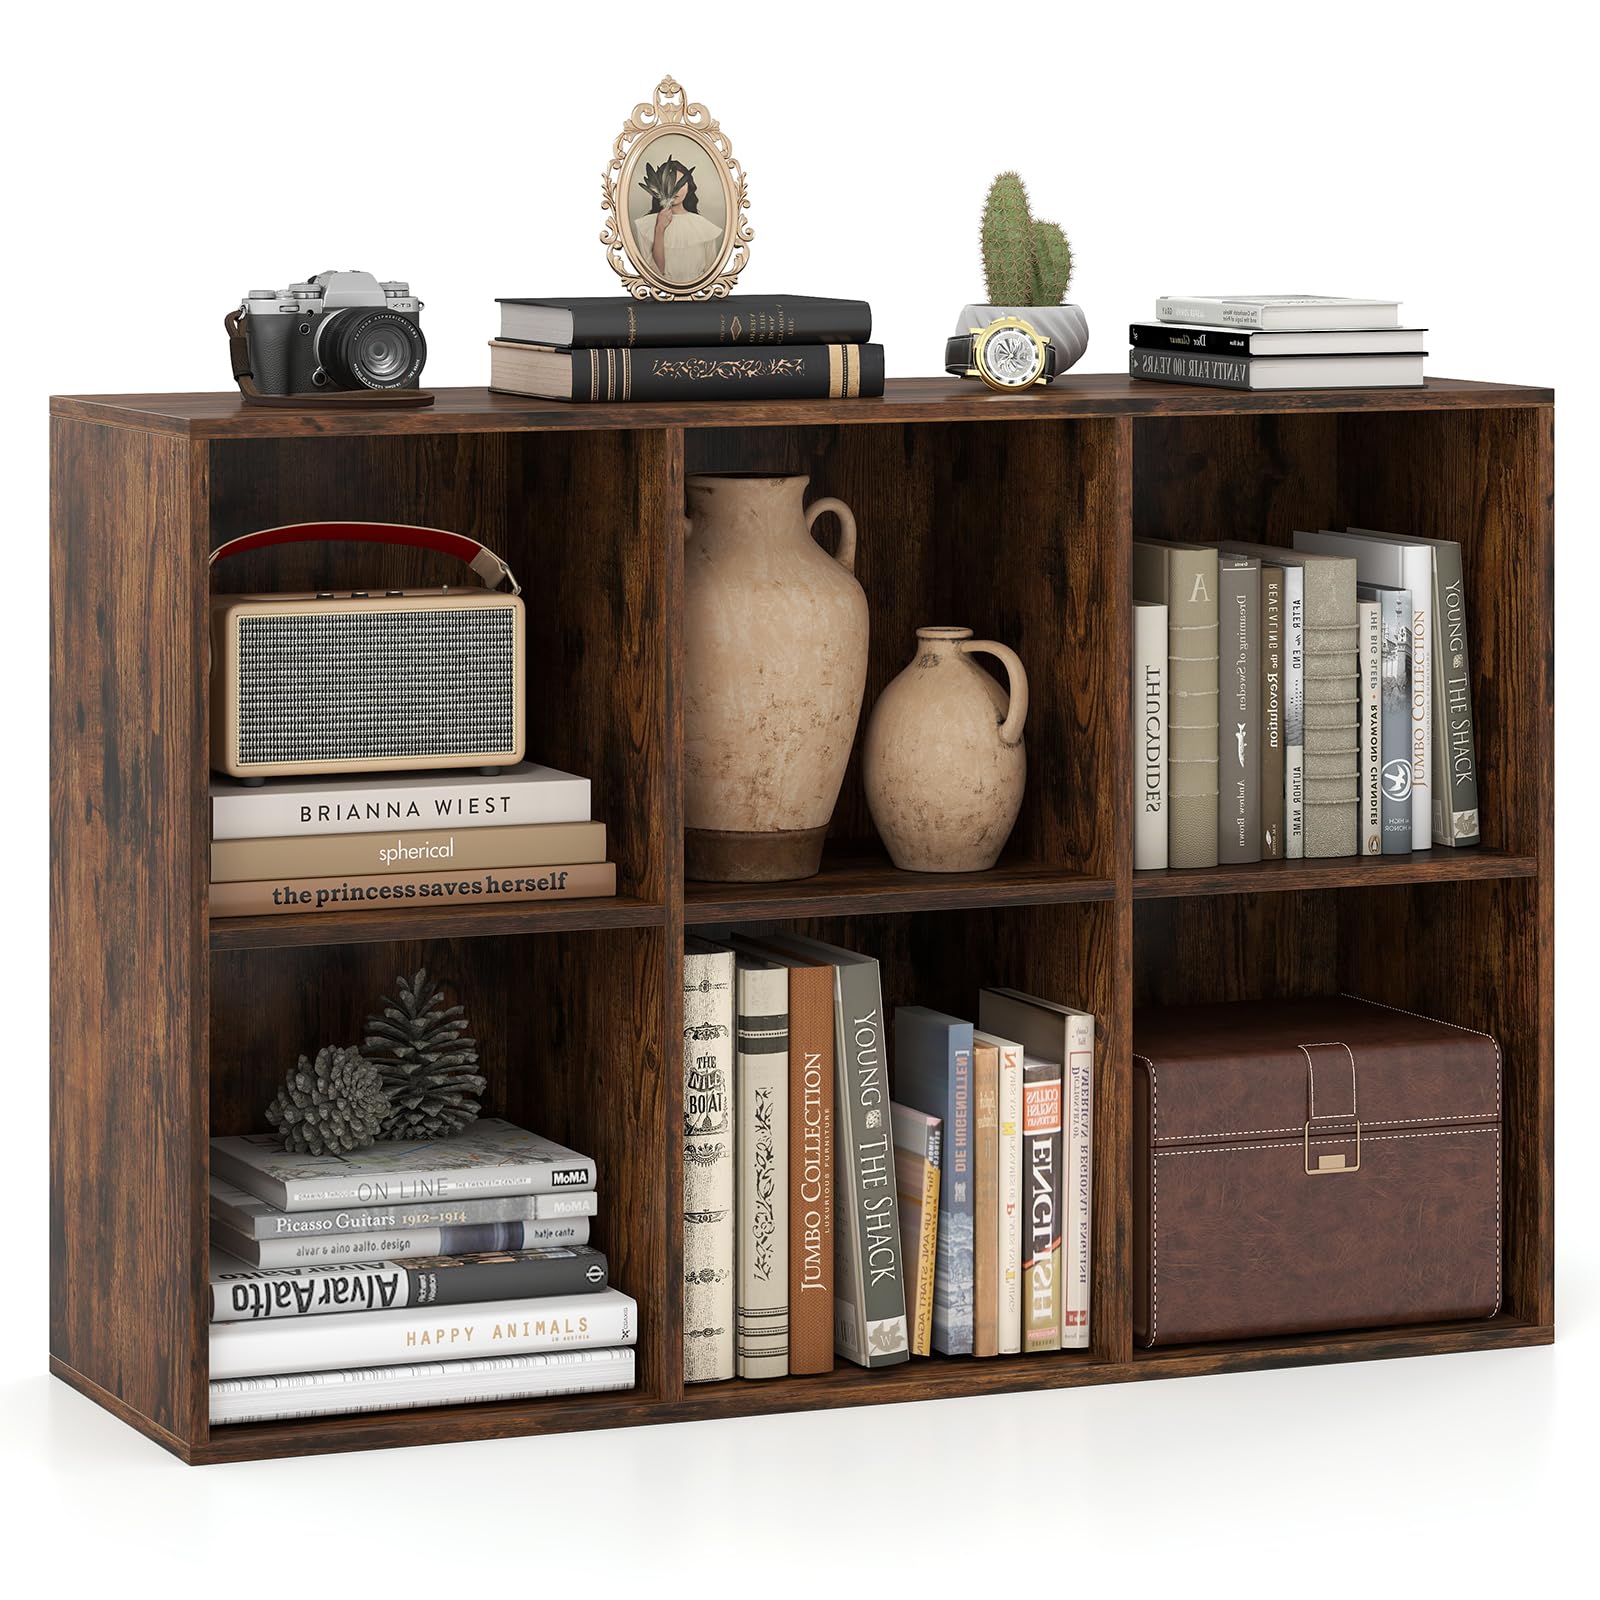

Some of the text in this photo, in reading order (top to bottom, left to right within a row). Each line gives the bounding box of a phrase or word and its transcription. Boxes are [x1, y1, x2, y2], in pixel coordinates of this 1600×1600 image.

[1445, 579, 1472, 786] YOUNG THE SHACK
[1412, 610, 1428, 788] JUMBO COLLECTION
[300, 796, 512, 823] BRIANNA WIEST
[378, 837, 454, 866] spherical
[272, 872, 569, 908] the princess saves herself
[696, 1056, 717, 1070] THE
[689, 1092, 724, 1114] BOAT
[854, 1009, 896, 1287] YOUNG THE SHACK
[553, 1170, 588, 1185] MoMA
[801, 1052, 826, 1293] JUMBO COLLECTION
[357, 1177, 449, 1202] ON LINE
[554, 1200, 590, 1213] MoMA
[276, 1218, 333, 1233] Picasso
[336, 1213, 396, 1229] Guitars
[534, 1228, 575, 1239] hatje cantz
[296, 1246, 320, 1257] alvar
[331, 1244, 350, 1254] aino
[380, 1239, 411, 1252] design
[218, 1262, 386, 1281] Alvar Aalto
[232, 1273, 399, 1318] Alvar Aalto
[406, 1316, 588, 1347] HAPPY ANIMALS
[880, 1333, 892, 1346] W
